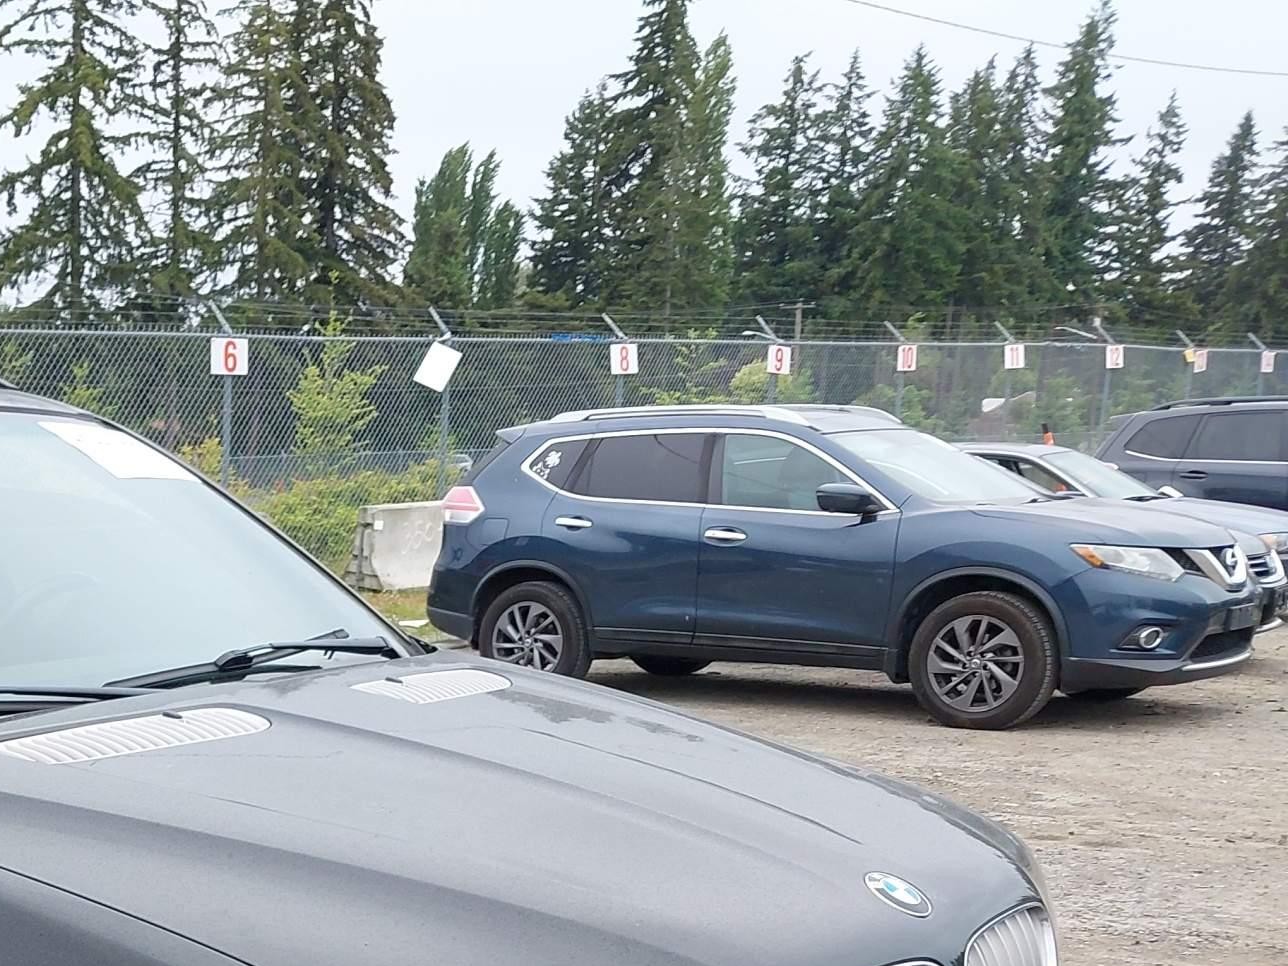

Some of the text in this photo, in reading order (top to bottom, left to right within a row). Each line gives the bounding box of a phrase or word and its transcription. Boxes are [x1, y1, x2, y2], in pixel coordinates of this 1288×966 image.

[224, 340, 237, 372] 6
[620, 346, 629, 371] 8
[775, 347, 783, 371] 9
[902, 346, 913, 369] 10
[1009, 346, 1019, 367] 11
